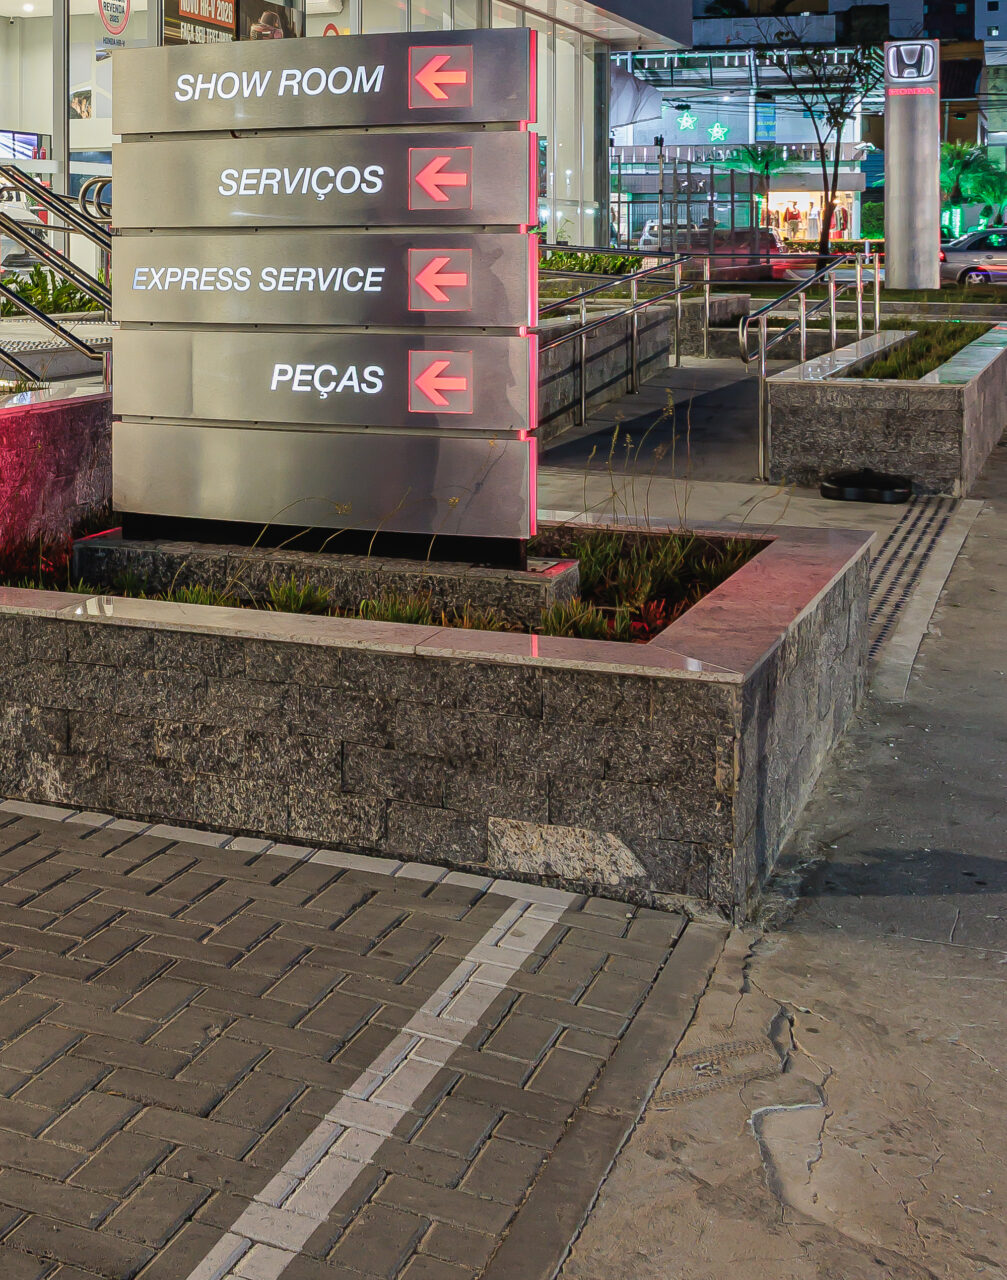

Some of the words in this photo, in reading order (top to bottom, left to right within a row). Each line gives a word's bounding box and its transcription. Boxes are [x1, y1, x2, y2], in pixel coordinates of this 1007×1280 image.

[103, 1, 125, 15] REVENDA
[216, 0, 233, 24] 2026
[175, 70, 272, 102] SHOW
[277, 65, 385, 97] ROOM
[888, 87, 935, 96] HONDA
[218, 165, 384, 200] SERVIÇOS
[132, 267, 252, 291] EXPRESS
[259, 267, 385, 292] SERVICE
[270, 364, 384, 398] PEÇAS
